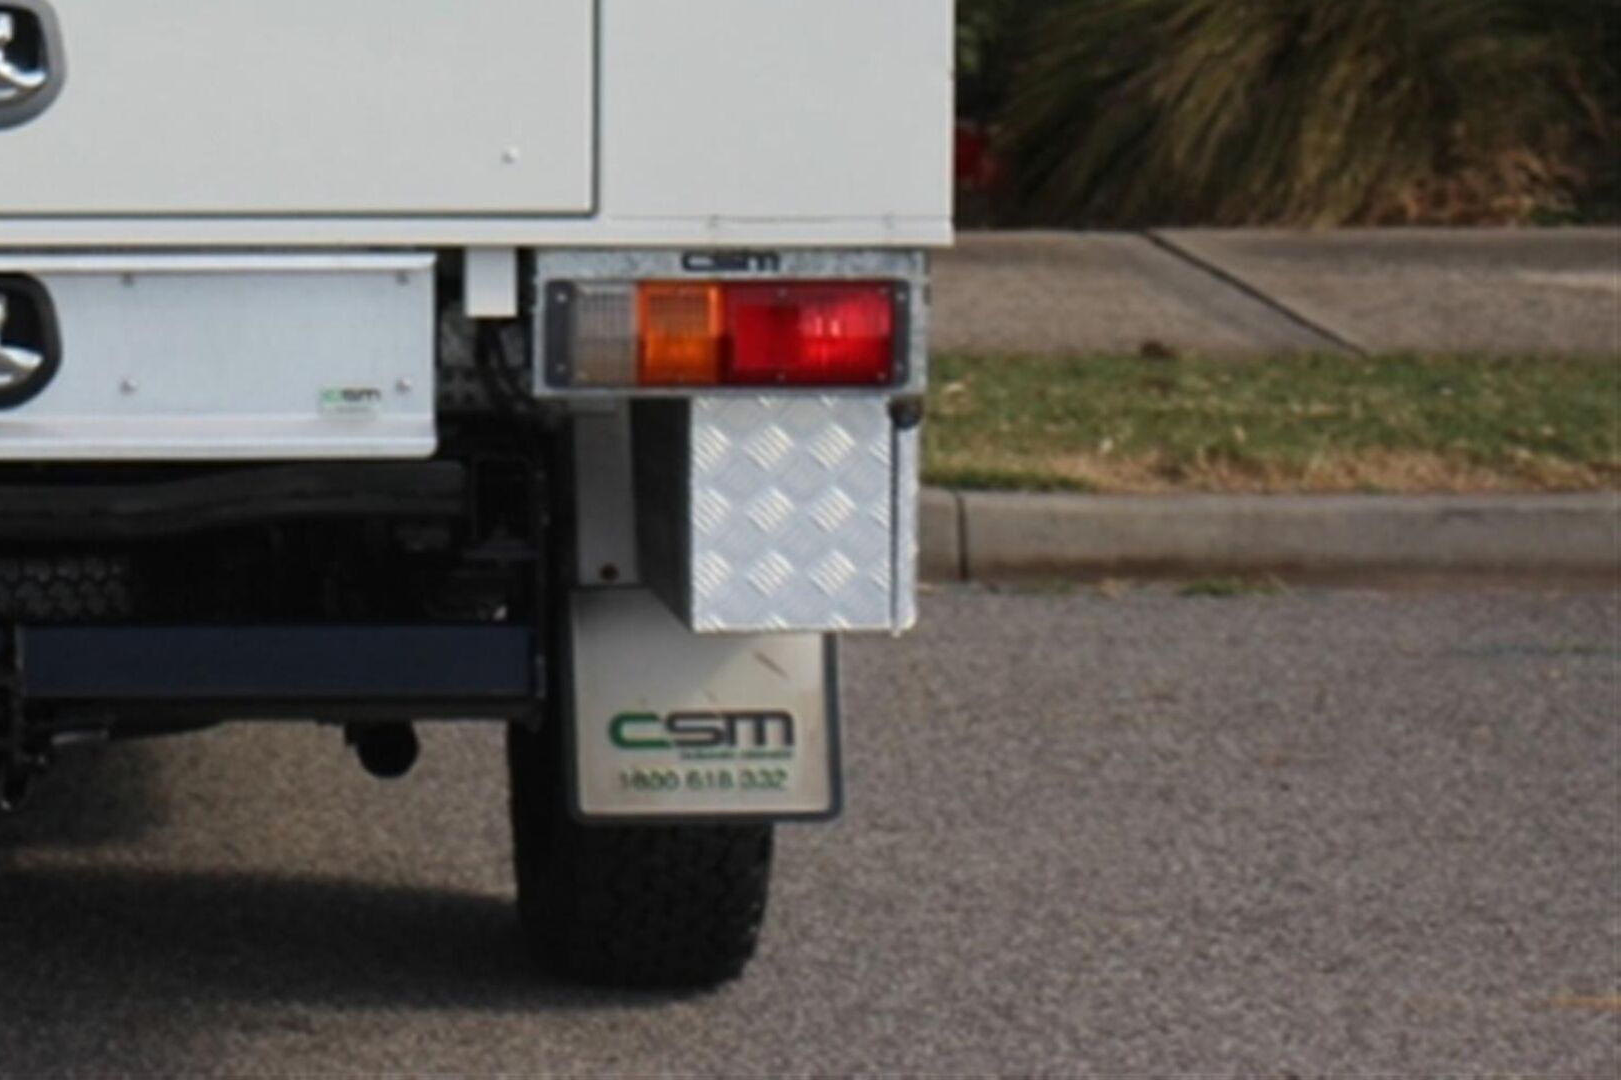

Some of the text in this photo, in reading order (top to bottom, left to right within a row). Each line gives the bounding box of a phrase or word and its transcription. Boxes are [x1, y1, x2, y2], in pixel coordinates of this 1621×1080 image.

[620, 769, 788, 790] 1800 618 332
